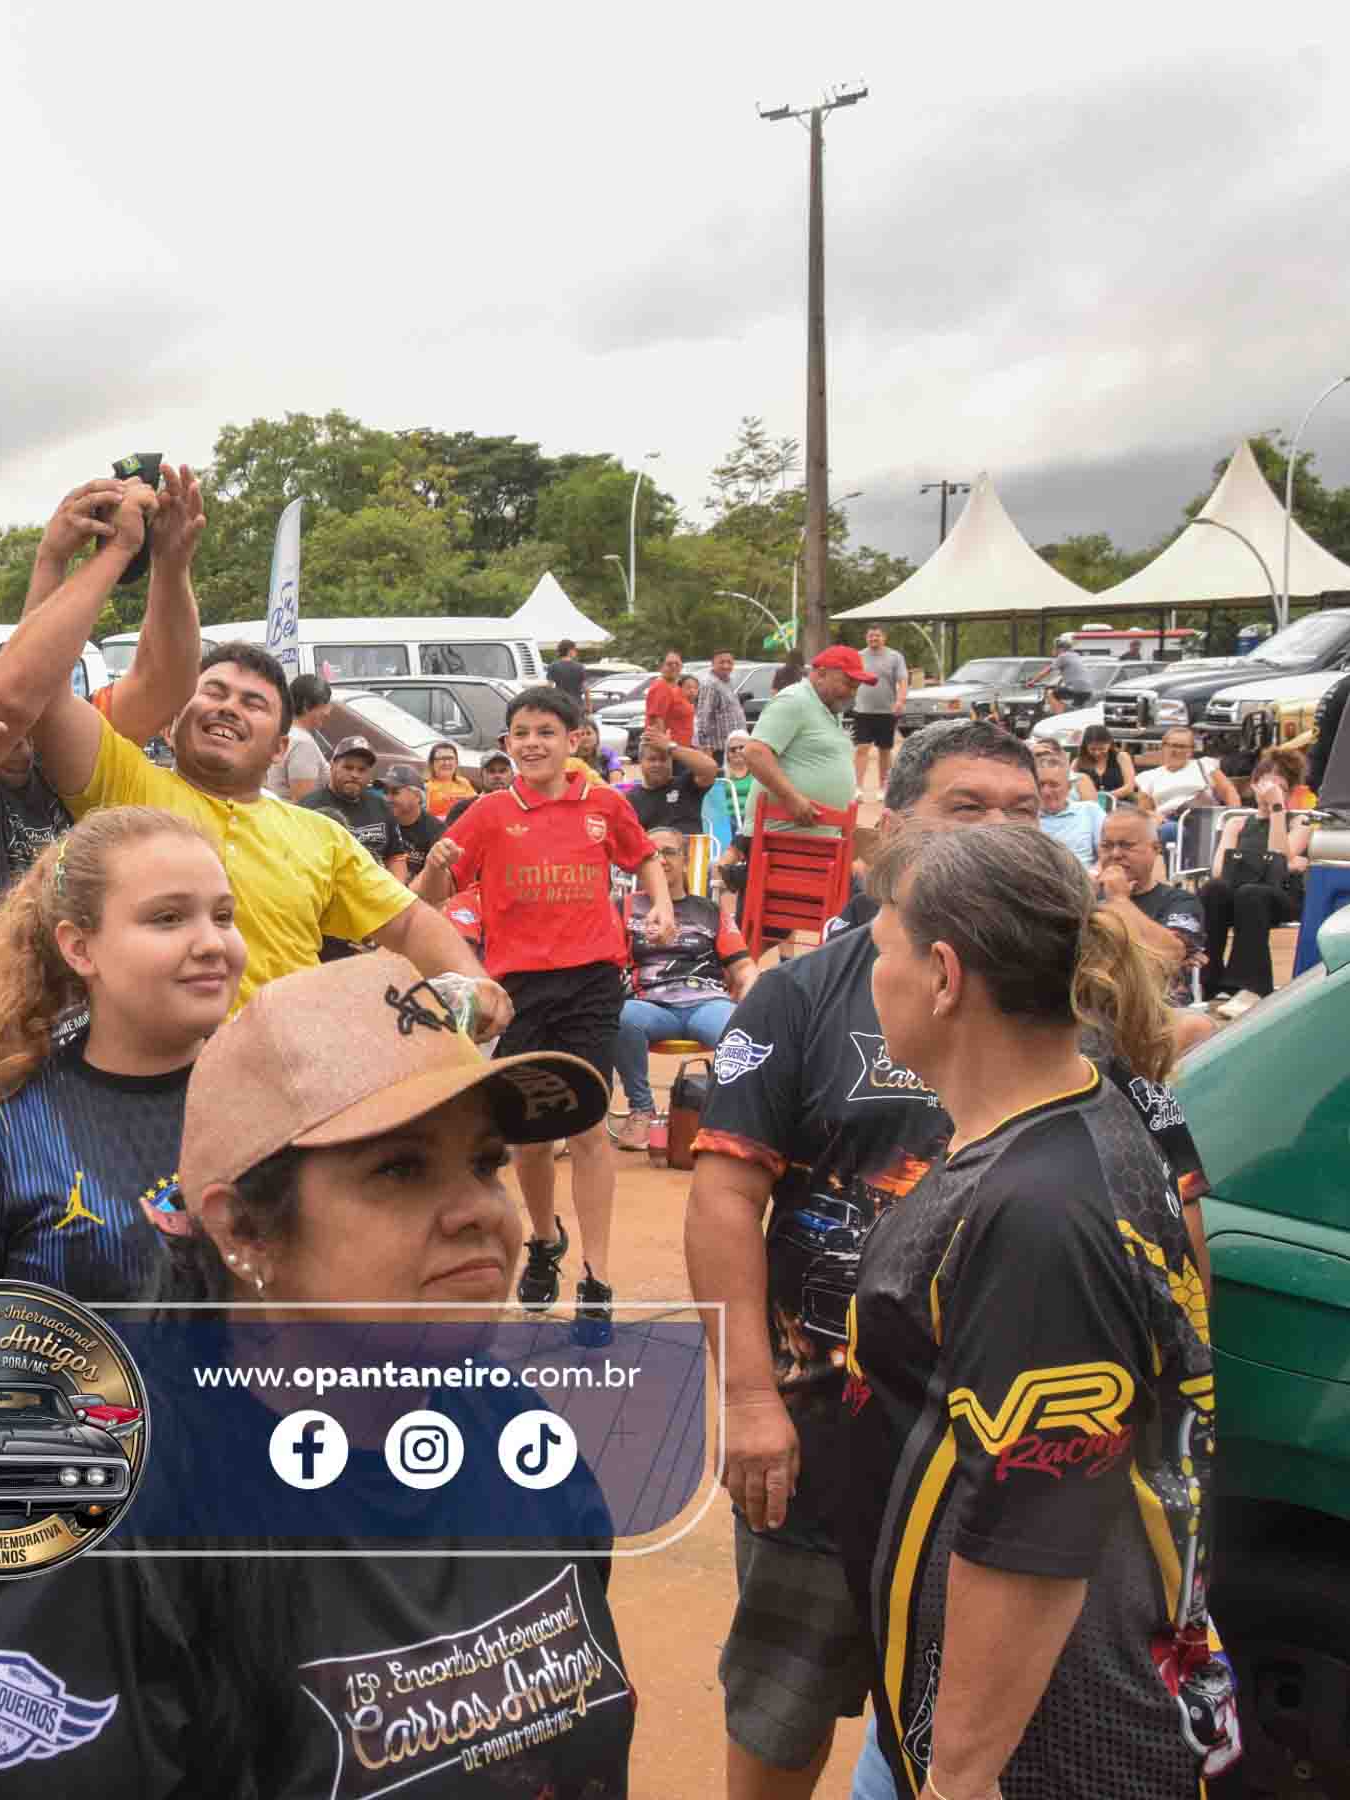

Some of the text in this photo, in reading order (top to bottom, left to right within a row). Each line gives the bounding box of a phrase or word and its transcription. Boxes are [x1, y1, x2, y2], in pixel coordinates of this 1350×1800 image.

[948, 1361, 1135, 1457] VR
[345, 1642, 601, 1770] Carros Antigos
[388, 1646, 475, 1694] Encontro
[461, 1747, 482, 1773] DE
[483, 1732, 523, 1768] PONTA
